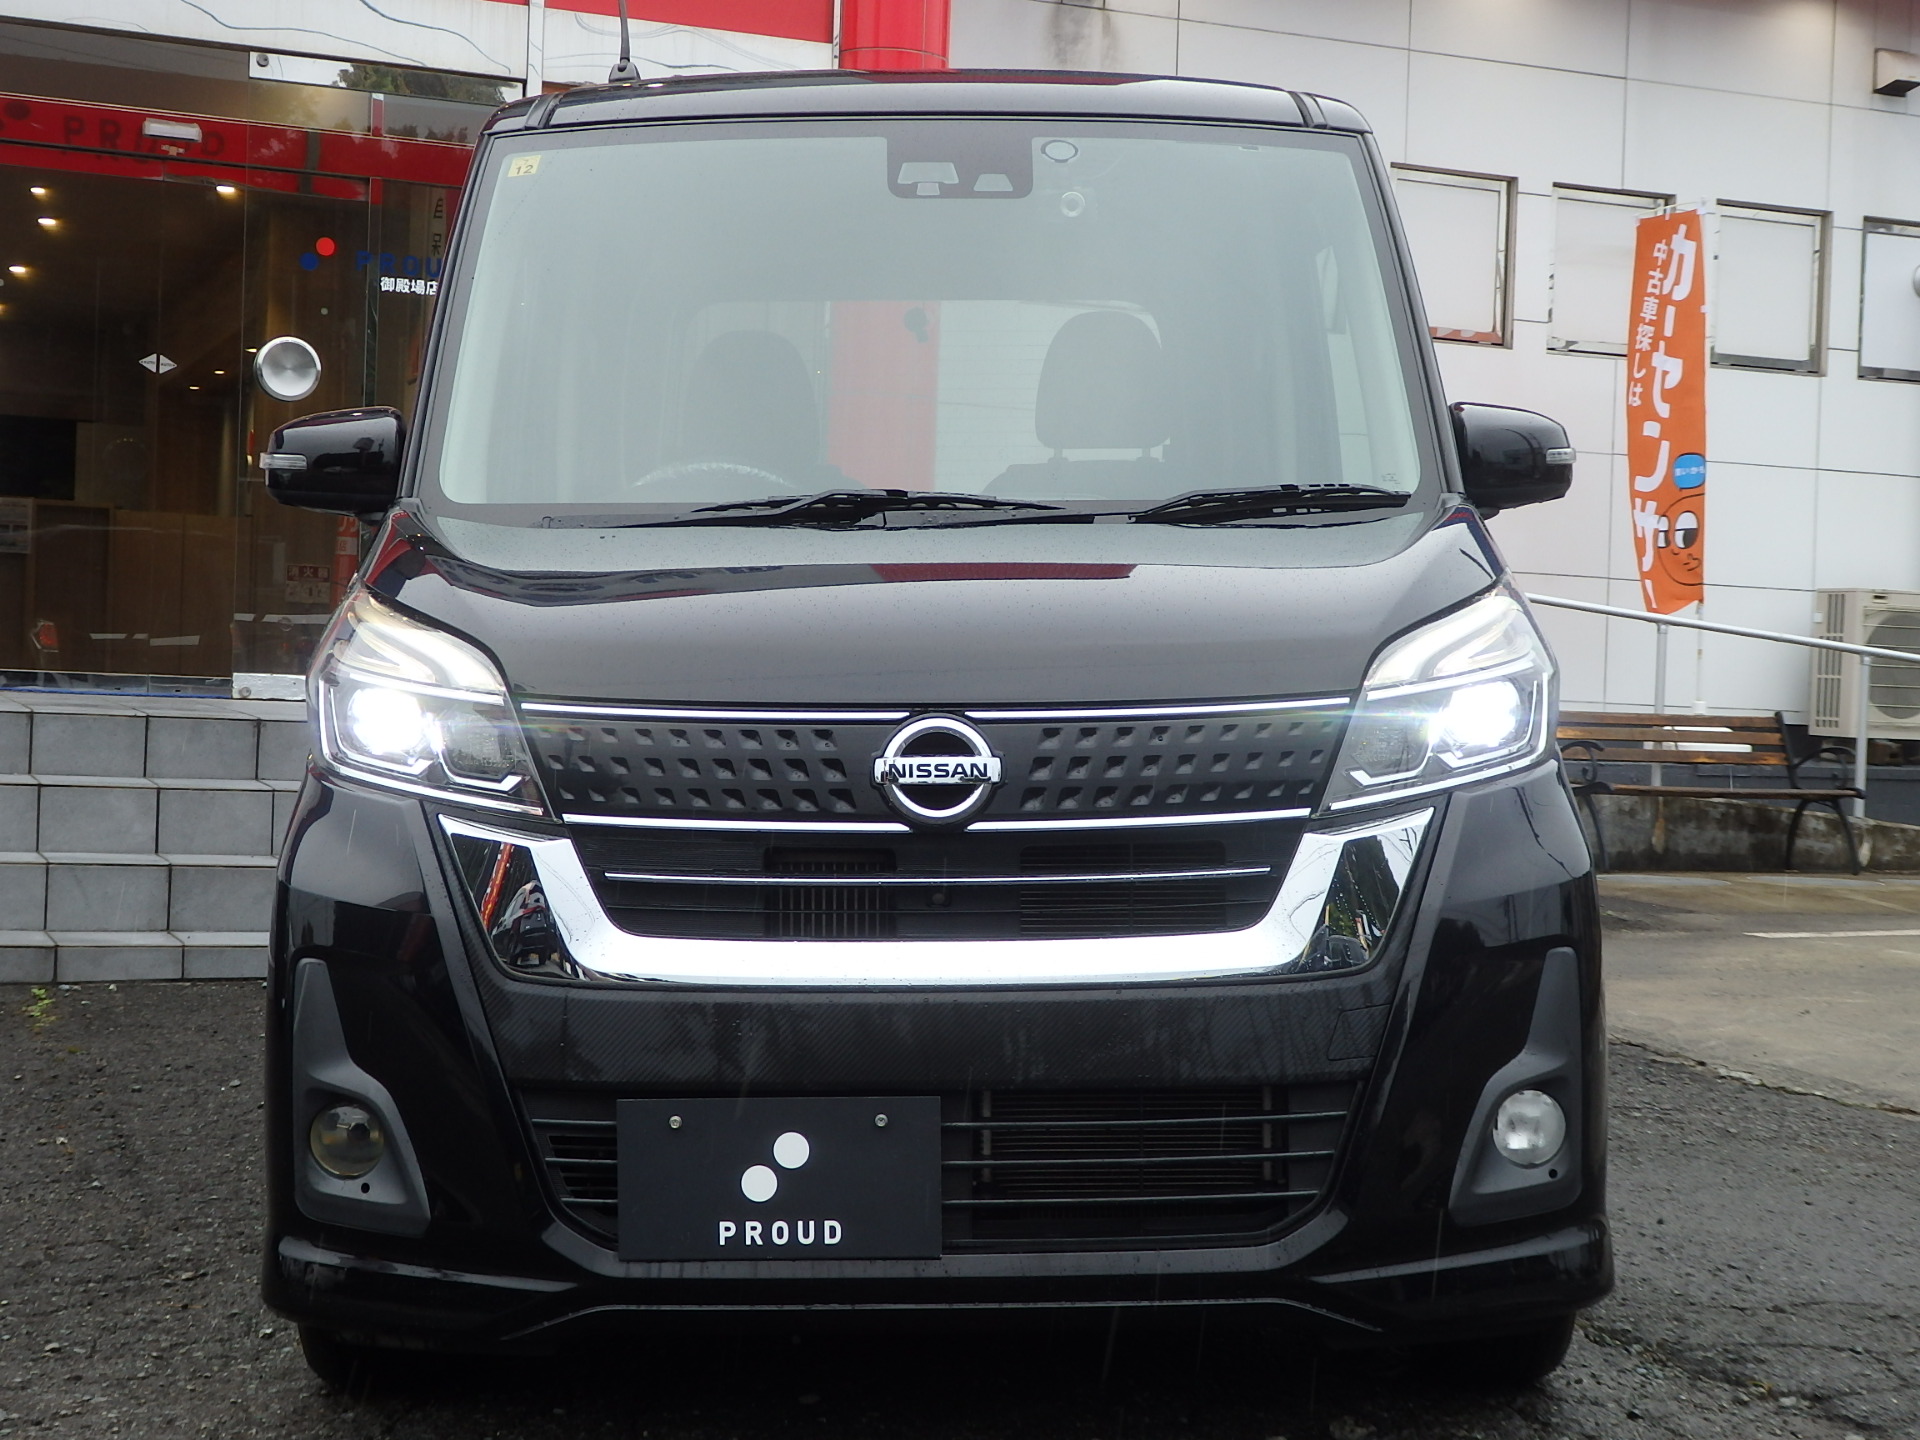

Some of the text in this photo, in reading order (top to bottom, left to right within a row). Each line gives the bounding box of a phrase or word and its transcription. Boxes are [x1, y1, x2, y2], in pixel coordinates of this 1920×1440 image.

[62, 114, 225, 165] PROD
[515, 164, 534, 176] 12
[380, 276, 439, 295] 御殿場店
[1628, 239, 1668, 407] 中古車探しは
[1633, 223, 1697, 609] カーセンサー
[888, 762, 988, 779] NISSAN
[718, 1220, 842, 1246] PROUD
